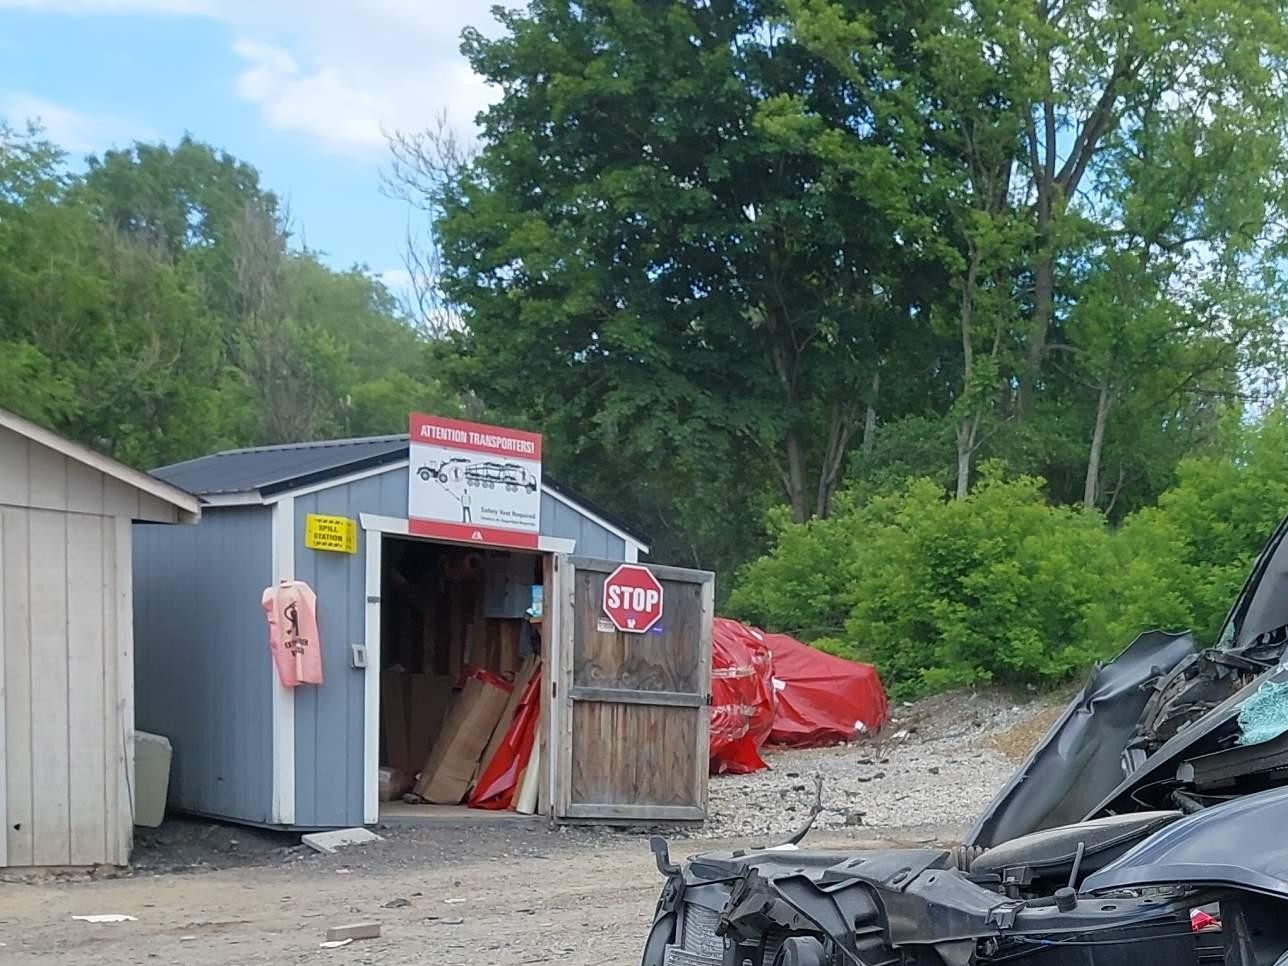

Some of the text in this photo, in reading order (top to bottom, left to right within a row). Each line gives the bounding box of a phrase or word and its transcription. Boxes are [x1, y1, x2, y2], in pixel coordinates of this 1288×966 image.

[420, 425, 535, 454] ATTENTION TRANSPORTERS!
[313, 533, 343, 542] STATION
[318, 525, 337, 533] SPILL
[608, 585, 659, 613] STOP
